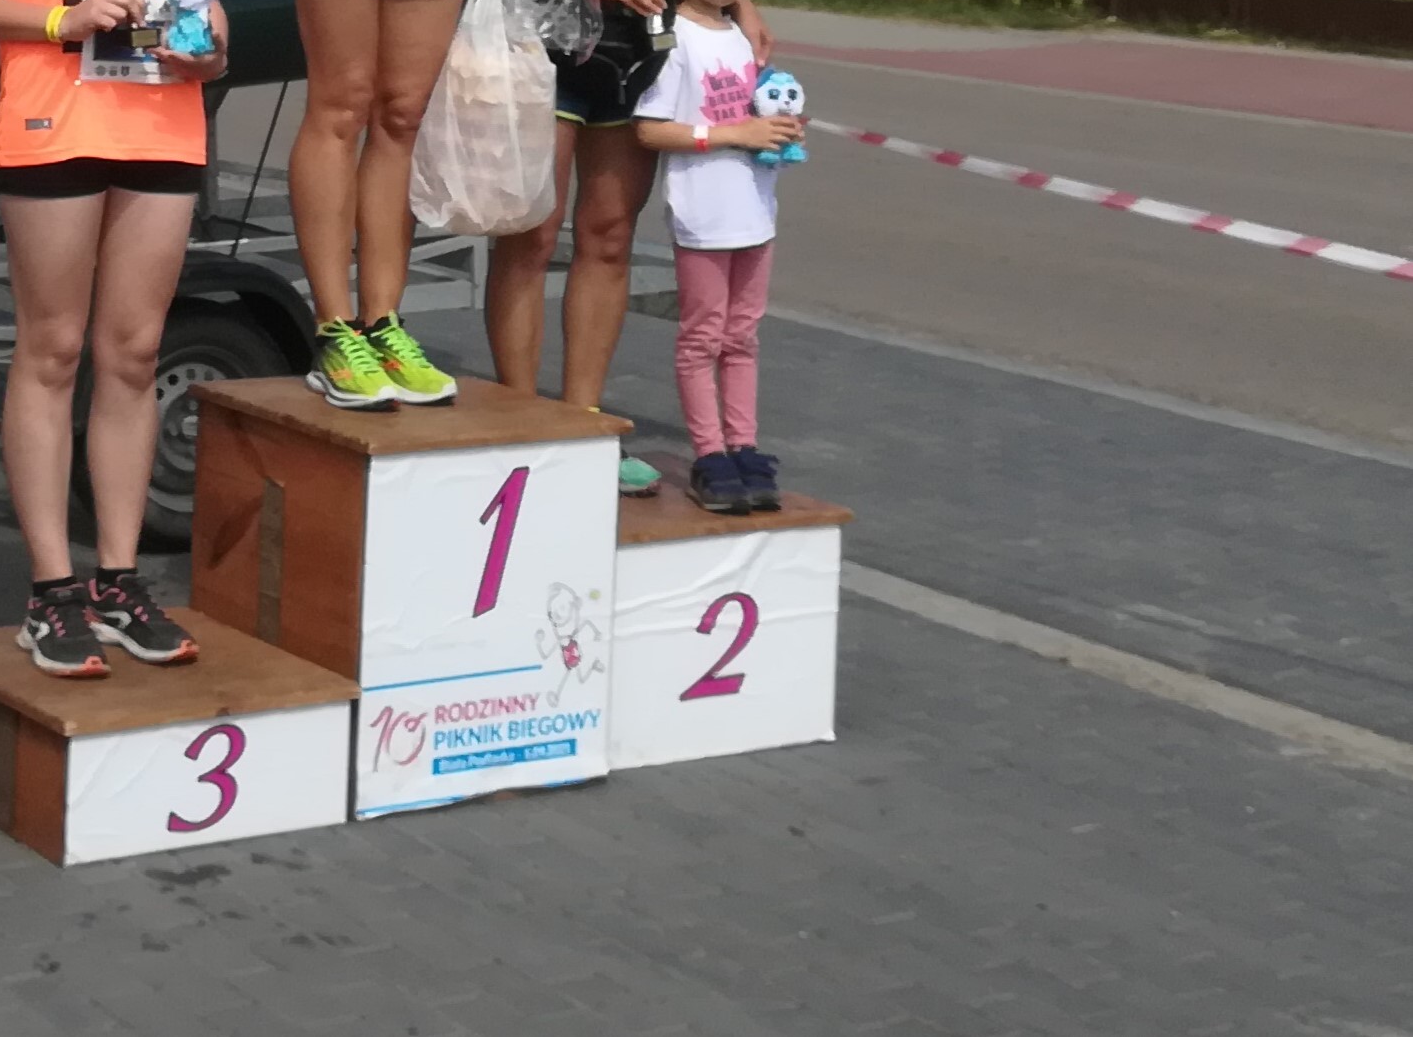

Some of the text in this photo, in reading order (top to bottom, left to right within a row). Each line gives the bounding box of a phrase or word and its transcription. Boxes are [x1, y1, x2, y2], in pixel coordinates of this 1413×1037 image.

[473, 466, 530, 618] 1
[679, 592, 759, 701] 2
[433, 708, 602, 751] PIKNIK BIEGOWY
[434, 692, 541, 725] RODZINNY
[167, 724, 246, 833] 3
